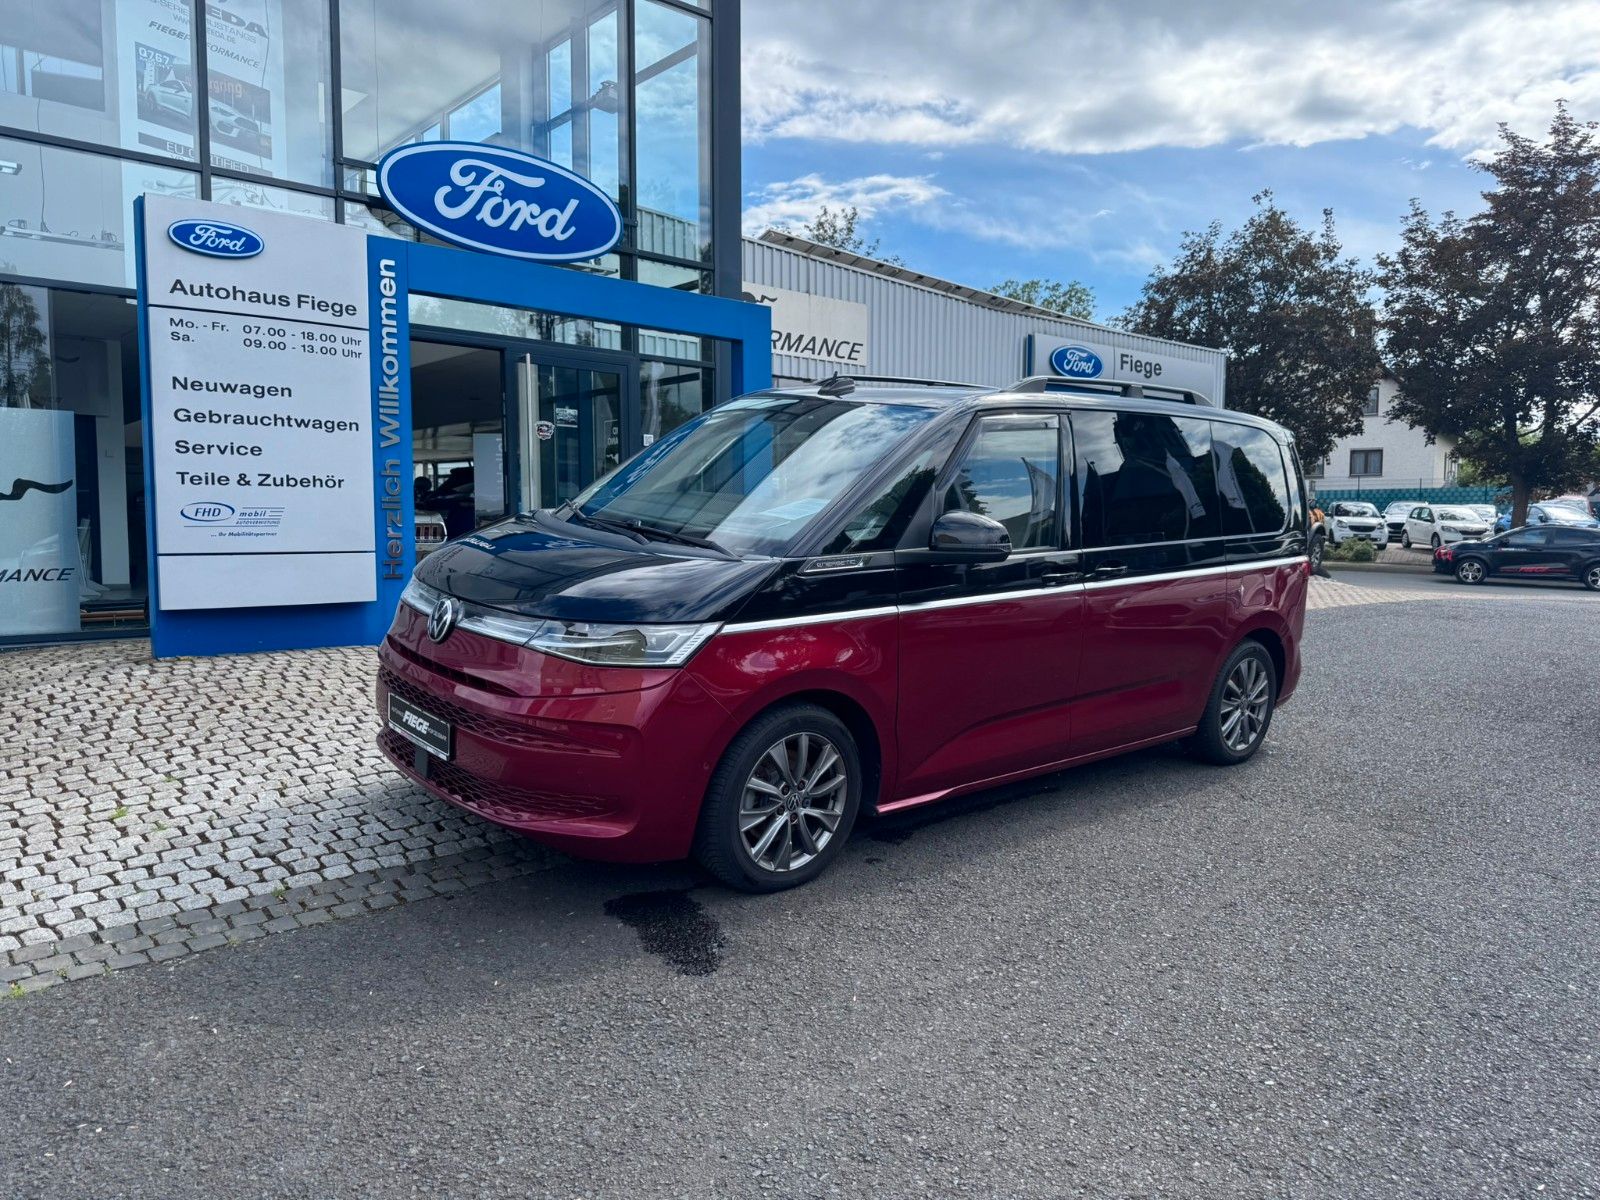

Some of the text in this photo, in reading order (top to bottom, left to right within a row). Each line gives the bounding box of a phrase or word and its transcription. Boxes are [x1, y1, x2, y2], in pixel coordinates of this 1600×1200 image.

[434, 158, 579, 241] Ford
[189, 225, 246, 252] Ford
[169, 278, 357, 317] Autohaus Fiege
[169, 317, 199, 329] Mo.
[211, 321, 229, 332] Fr.
[242, 324, 286, 338] 07.00
[301, 331, 337, 344] 18.00
[341, 335, 362, 347] Uhr
[170, 331, 195, 343] Sa.
[243, 338, 287, 351] 09.00
[301, 344, 337, 357] 13.00
[342, 348, 363, 359] Uhr
[770, 330, 864, 361] RMANCE
[1063, 349, 1163, 379] Ford Fiege
[172, 375, 292, 399] Neuwagen
[173, 407, 360, 434] Gebrauchtwagen
[378, 258, 404, 579] Herzlich Willkommen
[174, 439, 263, 457] Service
[176, 471, 345, 489] Teile & Zubehör
[194, 507, 267, 518] FHD mobil
[0, 567, 76, 582] ANCE
[402, 710, 430, 735] FIEGE
